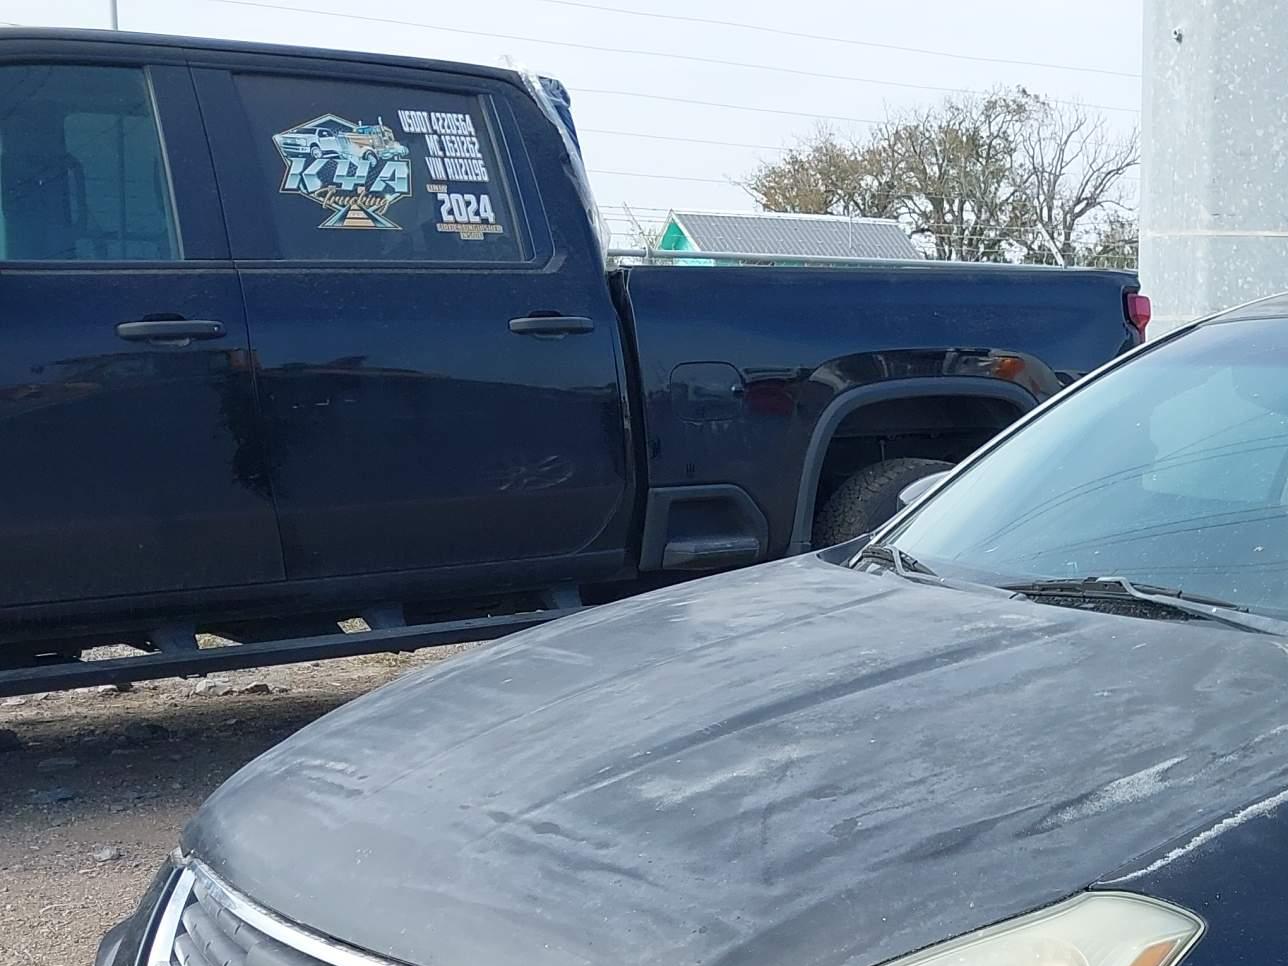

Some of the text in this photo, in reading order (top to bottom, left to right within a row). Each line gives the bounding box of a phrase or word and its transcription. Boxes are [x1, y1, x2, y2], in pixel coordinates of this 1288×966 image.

[397, 110, 433, 133] USDOT
[425, 134, 444, 157] MC
[425, 156, 447, 180] VIN
[315, 185, 390, 215] Trucking
[437, 193, 496, 224] 2024
